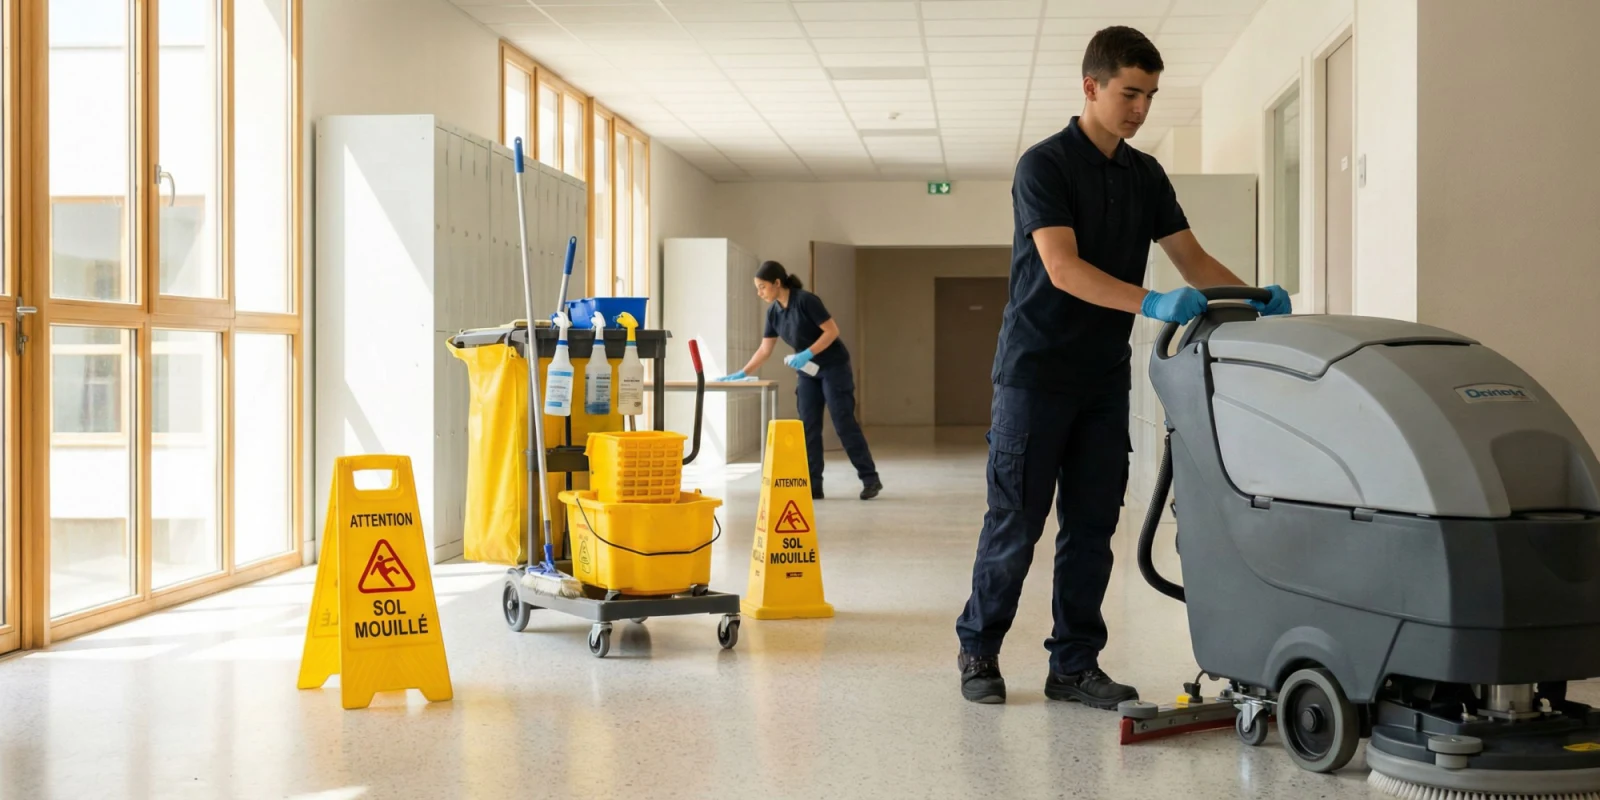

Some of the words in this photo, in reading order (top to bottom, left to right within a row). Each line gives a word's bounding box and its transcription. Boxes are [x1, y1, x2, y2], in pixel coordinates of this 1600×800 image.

[774, 478, 808, 488] ATTENTION
[350, 512, 413, 528] ATTENTION
[782, 538, 803, 549] SOL
[770, 549, 816, 564] MOUILLÉ
[373, 599, 407, 616] SOL
[355, 613, 429, 639] MOUILLÉ
